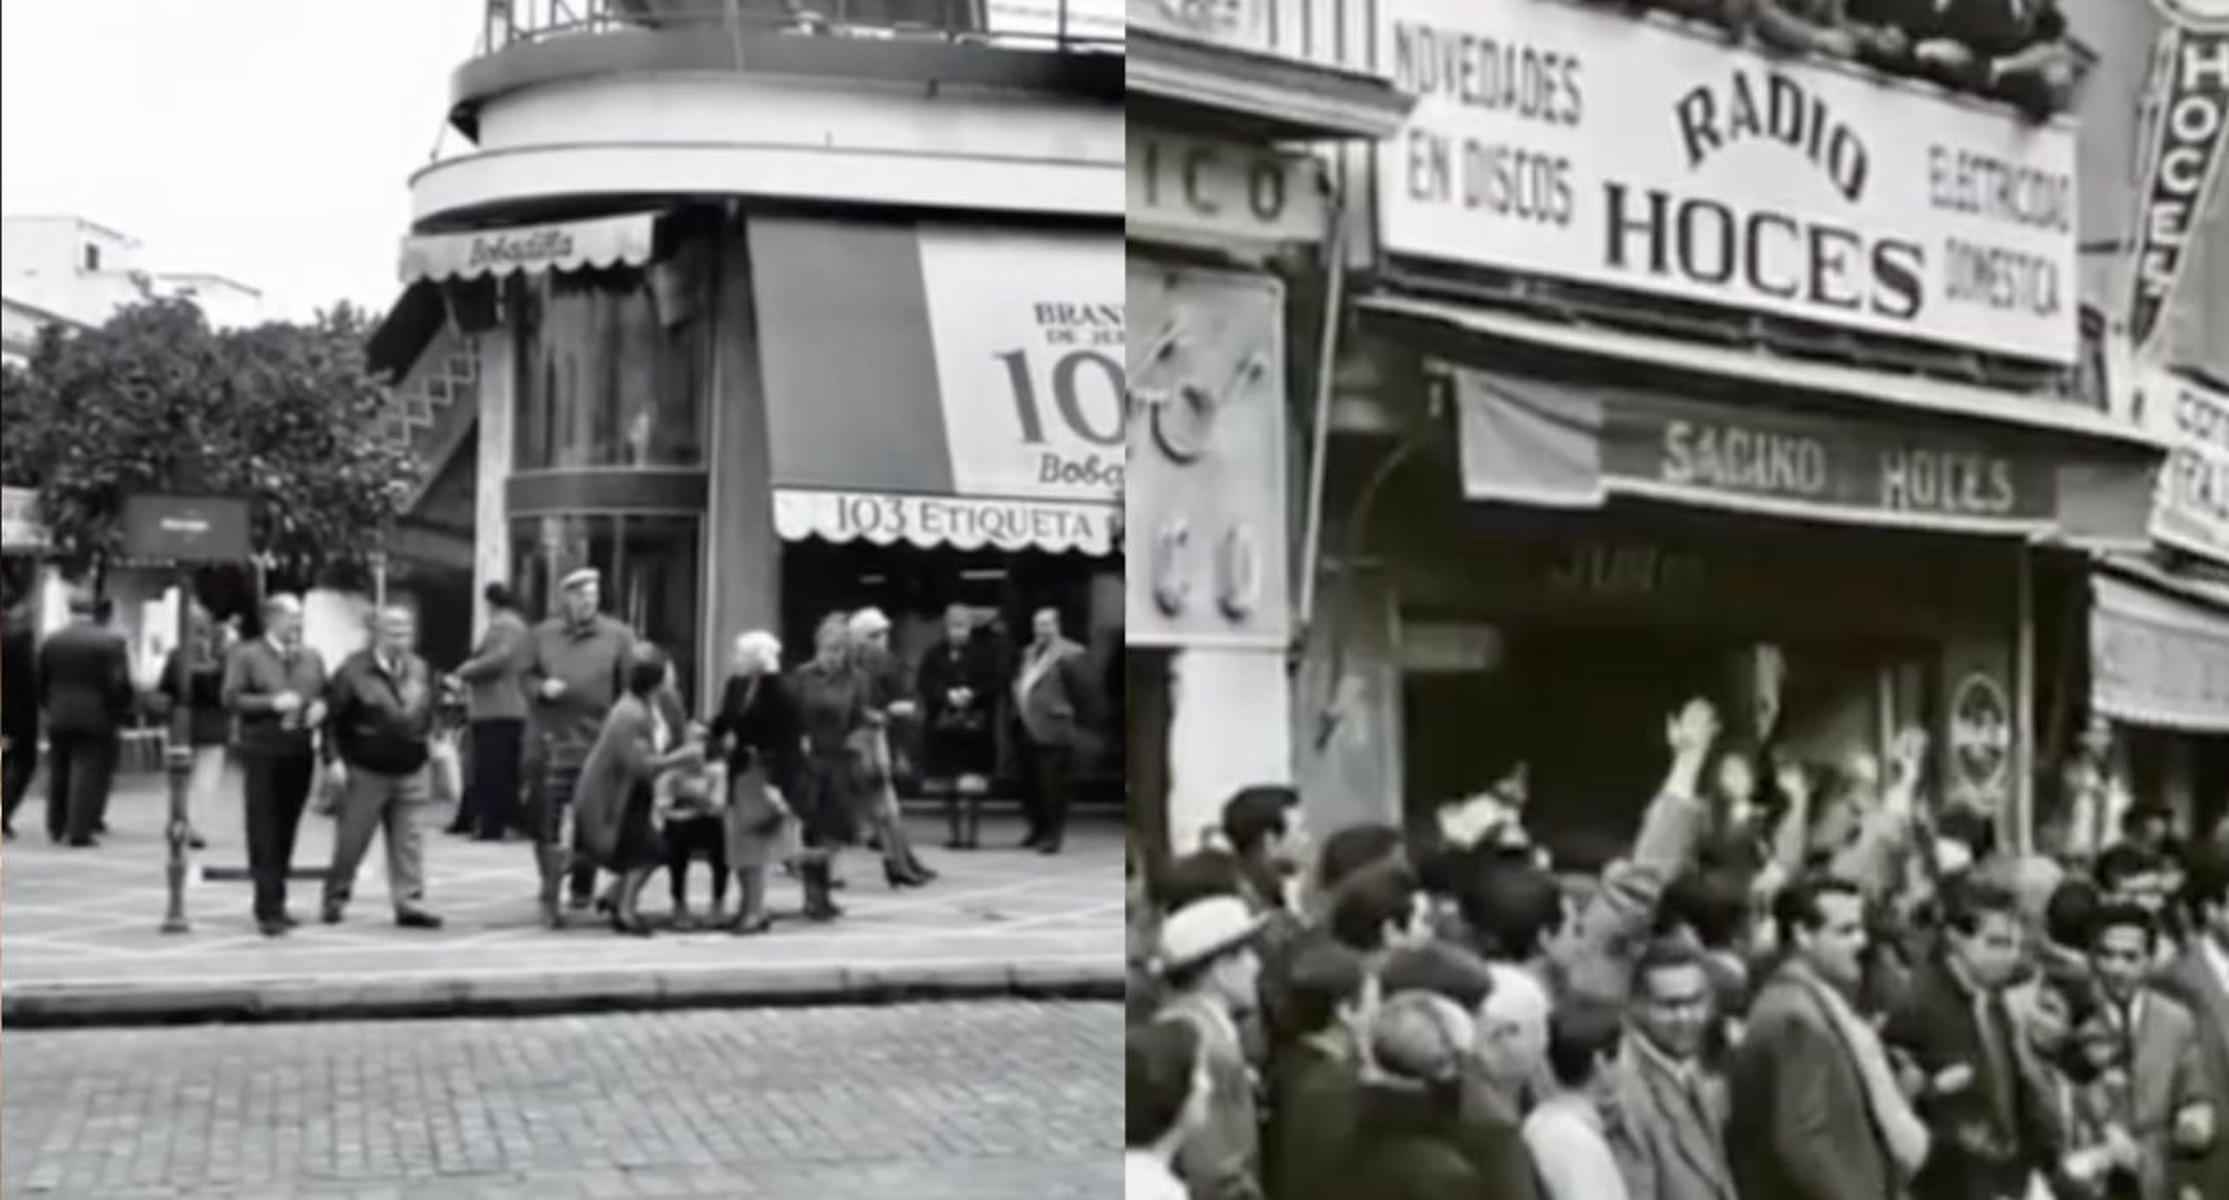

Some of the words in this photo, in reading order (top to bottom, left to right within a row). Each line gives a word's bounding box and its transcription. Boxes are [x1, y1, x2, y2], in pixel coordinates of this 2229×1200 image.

[1675, 69, 1868, 203] RADIO
[2143, 42, 2229, 297] HOCES
[1604, 180, 1925, 321] HOCES
[835, 497, 907, 534] 103
[918, 505, 1094, 541] ETIQUETA
[1880, 450, 2014, 514] HOCES
